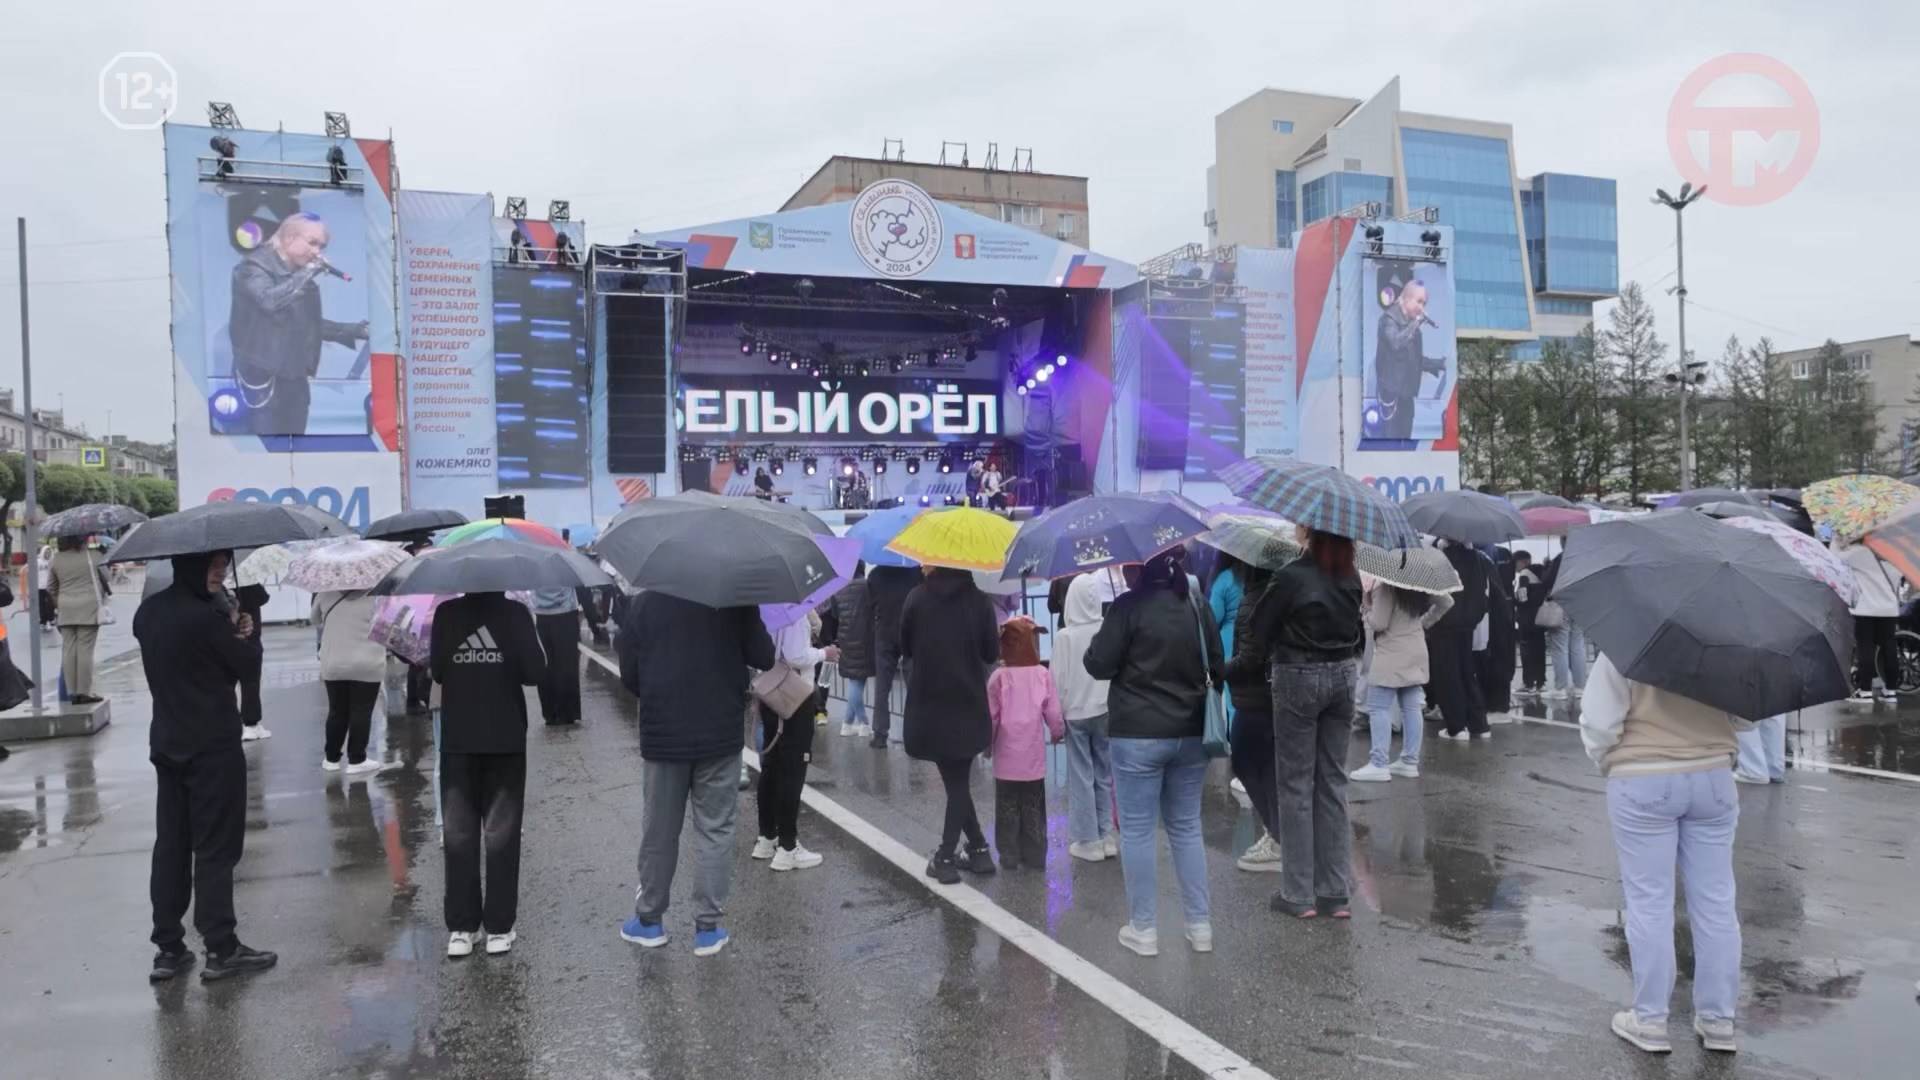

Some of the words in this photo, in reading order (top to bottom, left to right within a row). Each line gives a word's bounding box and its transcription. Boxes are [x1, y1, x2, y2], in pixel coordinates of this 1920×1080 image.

[409, 260, 481, 272] СОХРАНЕНИЕ
[886, 263, 911, 273] 2024
[409, 273, 472, 284] СЕМЕЙНЫХ
[410, 286, 477, 297] ЦЕННОСТЕЙ
[421, 301, 442, 310] ЭТО
[445, 301, 480, 311] ЗАЛОГ
[411, 314, 479, 324] УСПЕШНОГО
[422, 327, 486, 337] ЗДОРОВОГО
[411, 340, 470, 350] БУДУЩЕГО
[412, 353, 457, 363] НАШЕГО
[858, 384, 998, 434] ОРЁЛ
[466, 447, 491, 455] ОЛЕГ
[415, 458, 492, 469] КОЖЕМЯКО
[452, 649, 504, 664] adidas
